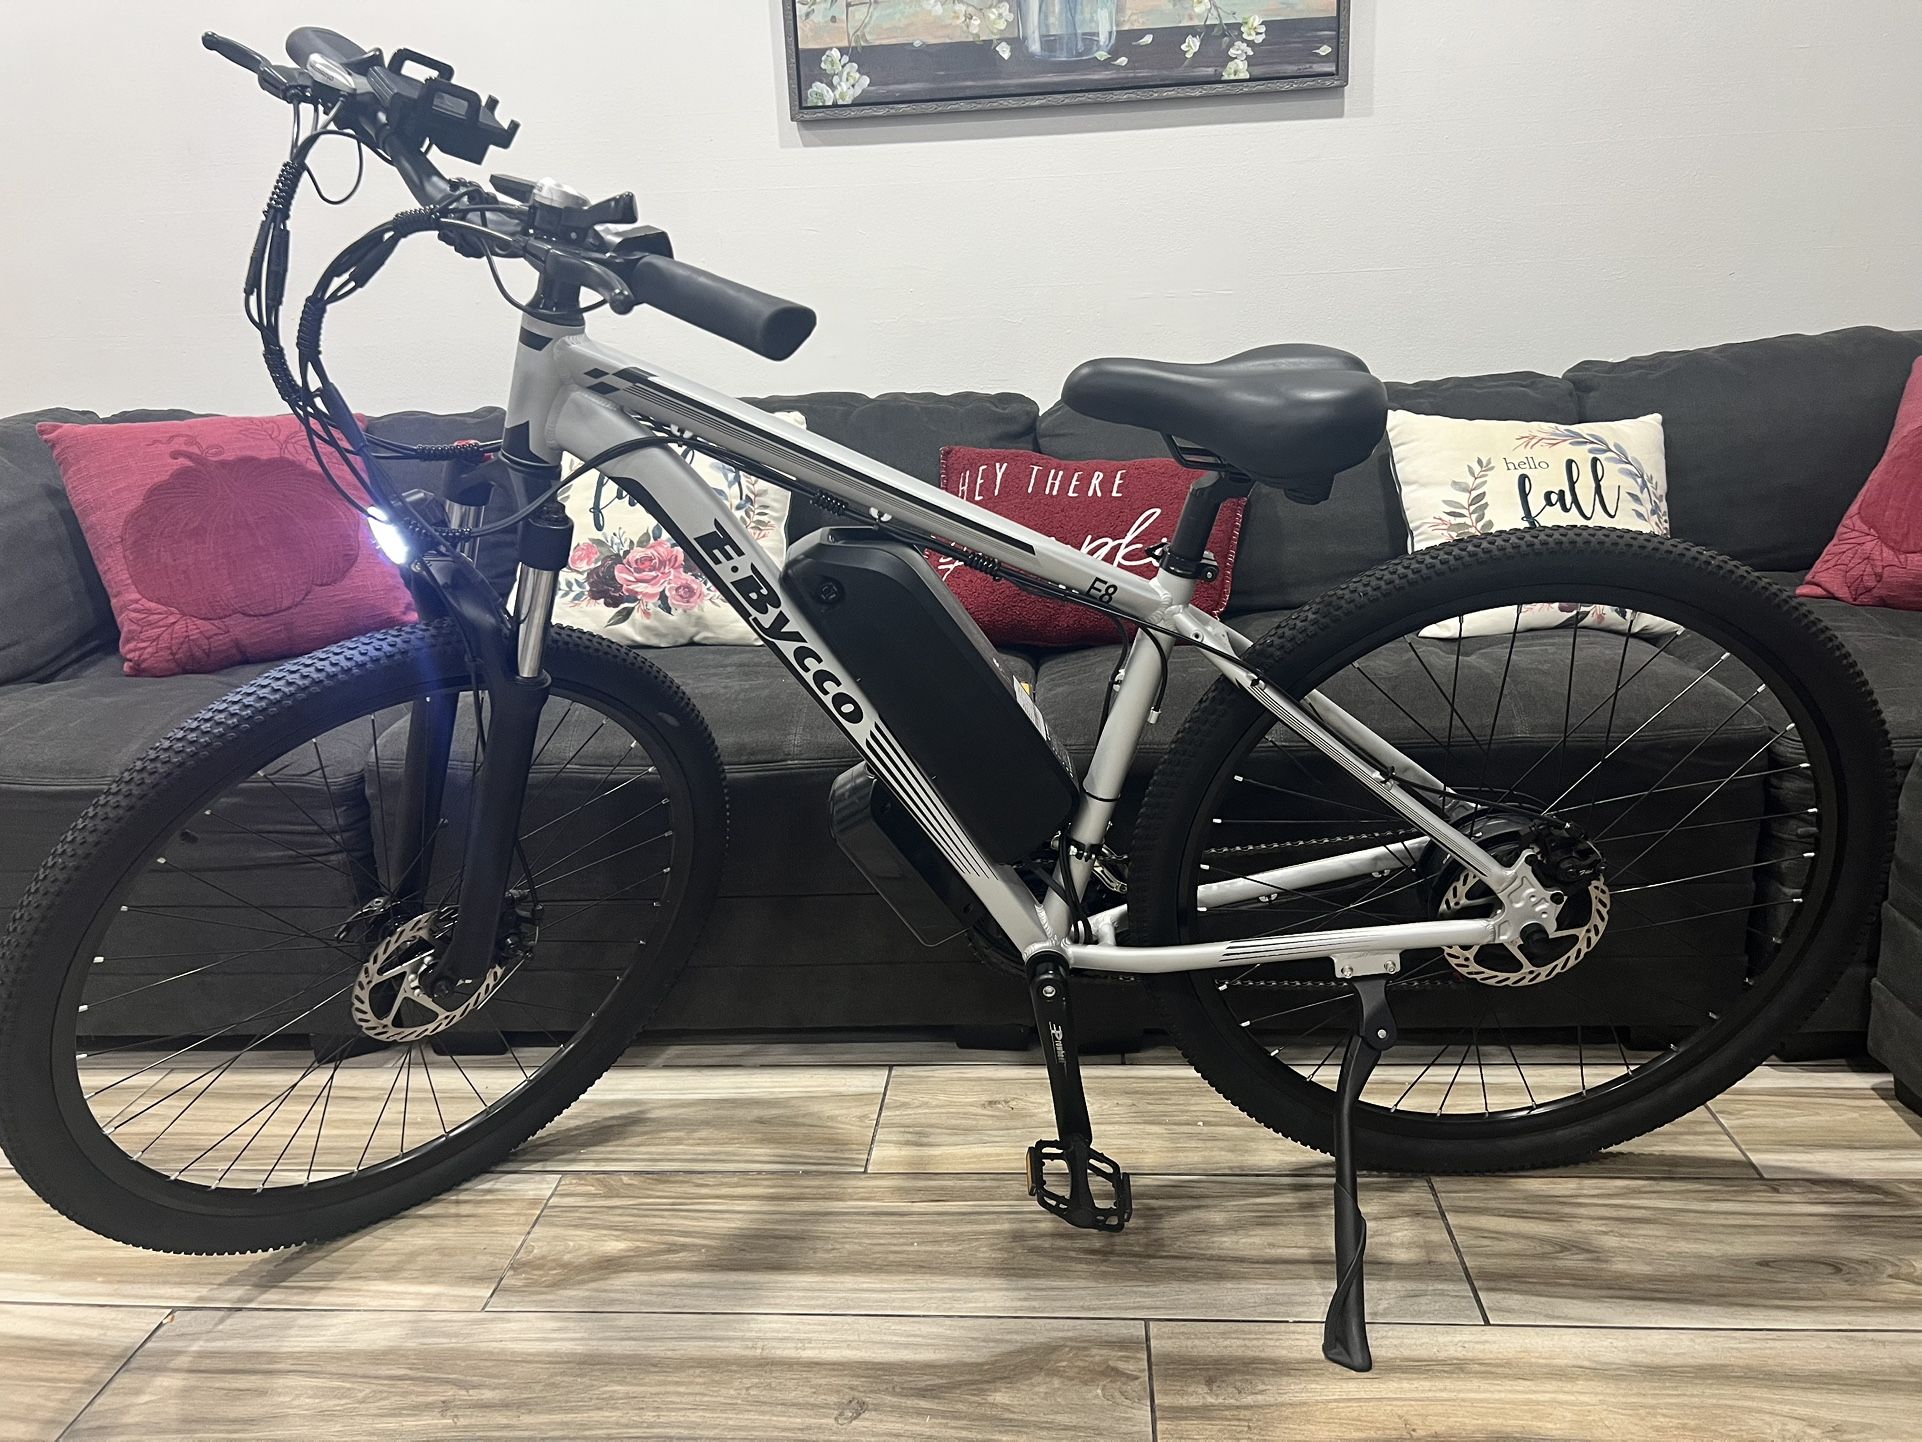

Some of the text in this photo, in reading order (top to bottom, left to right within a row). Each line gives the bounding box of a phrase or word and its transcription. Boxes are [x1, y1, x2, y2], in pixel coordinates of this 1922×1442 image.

[1502, 456, 1550, 471] hello
[958, 462, 1127, 500] HEY THERE
[1517, 456, 1620, 527] fall
[1086, 576, 1118, 604] E8
